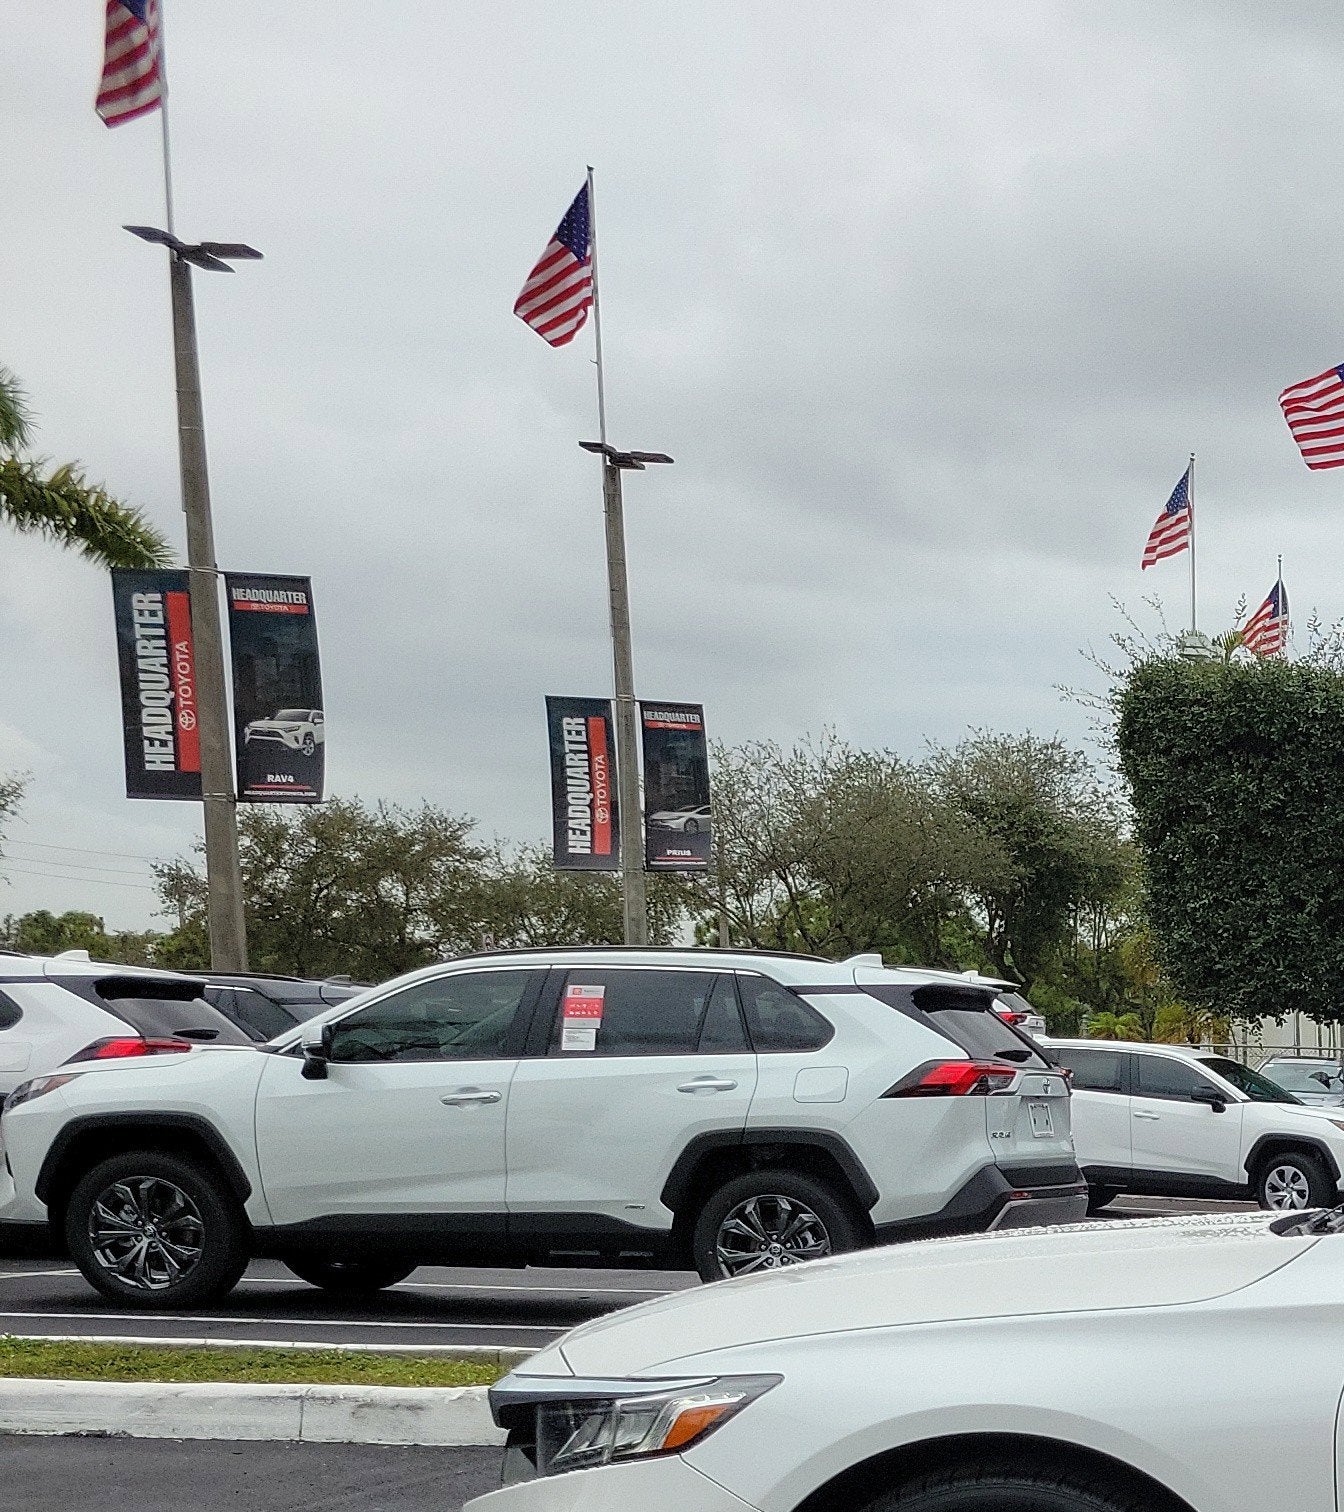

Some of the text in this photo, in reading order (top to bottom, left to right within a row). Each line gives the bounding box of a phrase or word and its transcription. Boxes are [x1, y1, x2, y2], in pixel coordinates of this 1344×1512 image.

[232, 588, 307, 604] HEADQUARTER
[133, 592, 176, 771] HEADQUARTER
[175, 640, 196, 708] TOYOTA
[643, 710, 701, 724] HEADQUARTER
[267, 774, 294, 783] RAV4
[563, 717, 594, 854] HEADQUARTER
[595, 754, 608, 805] TOYOTA
